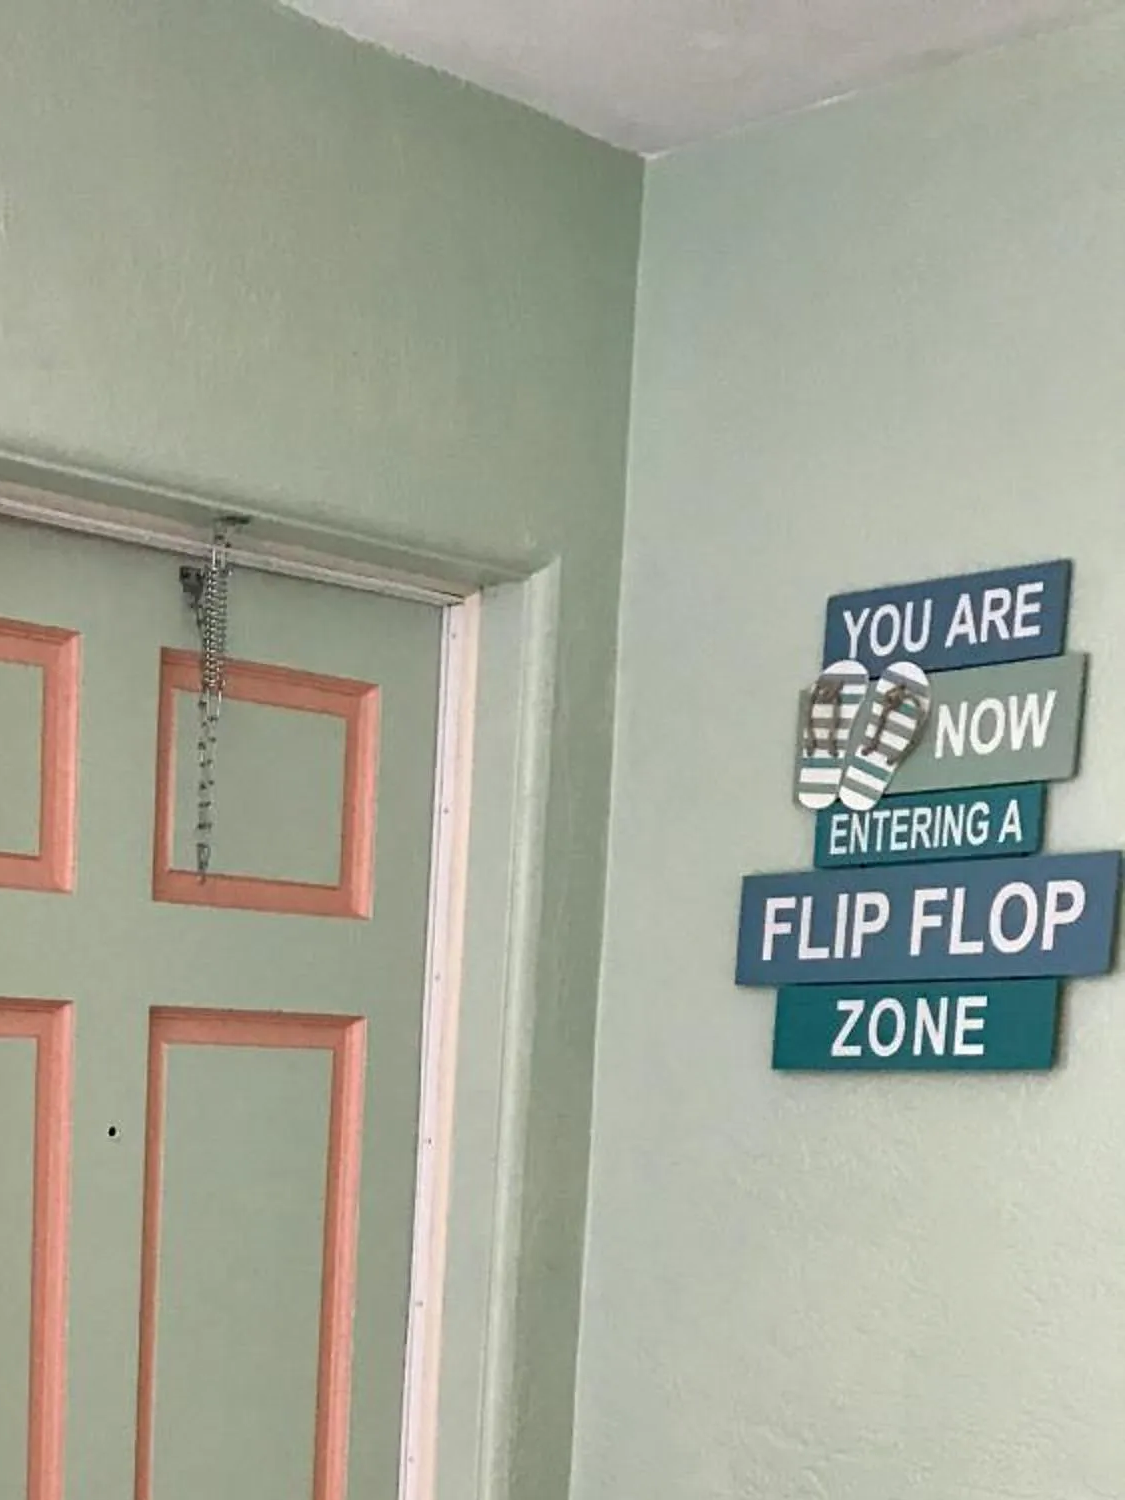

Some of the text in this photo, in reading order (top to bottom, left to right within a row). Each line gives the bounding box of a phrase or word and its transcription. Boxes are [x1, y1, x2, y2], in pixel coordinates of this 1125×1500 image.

[843, 582, 1044, 658] YOU ARE
[935, 690, 1056, 758] NOW
[829, 799, 1023, 855] ENTERING A
[761, 880, 1086, 961] FLIP FLOP
[831, 996, 988, 1057] ZONE
